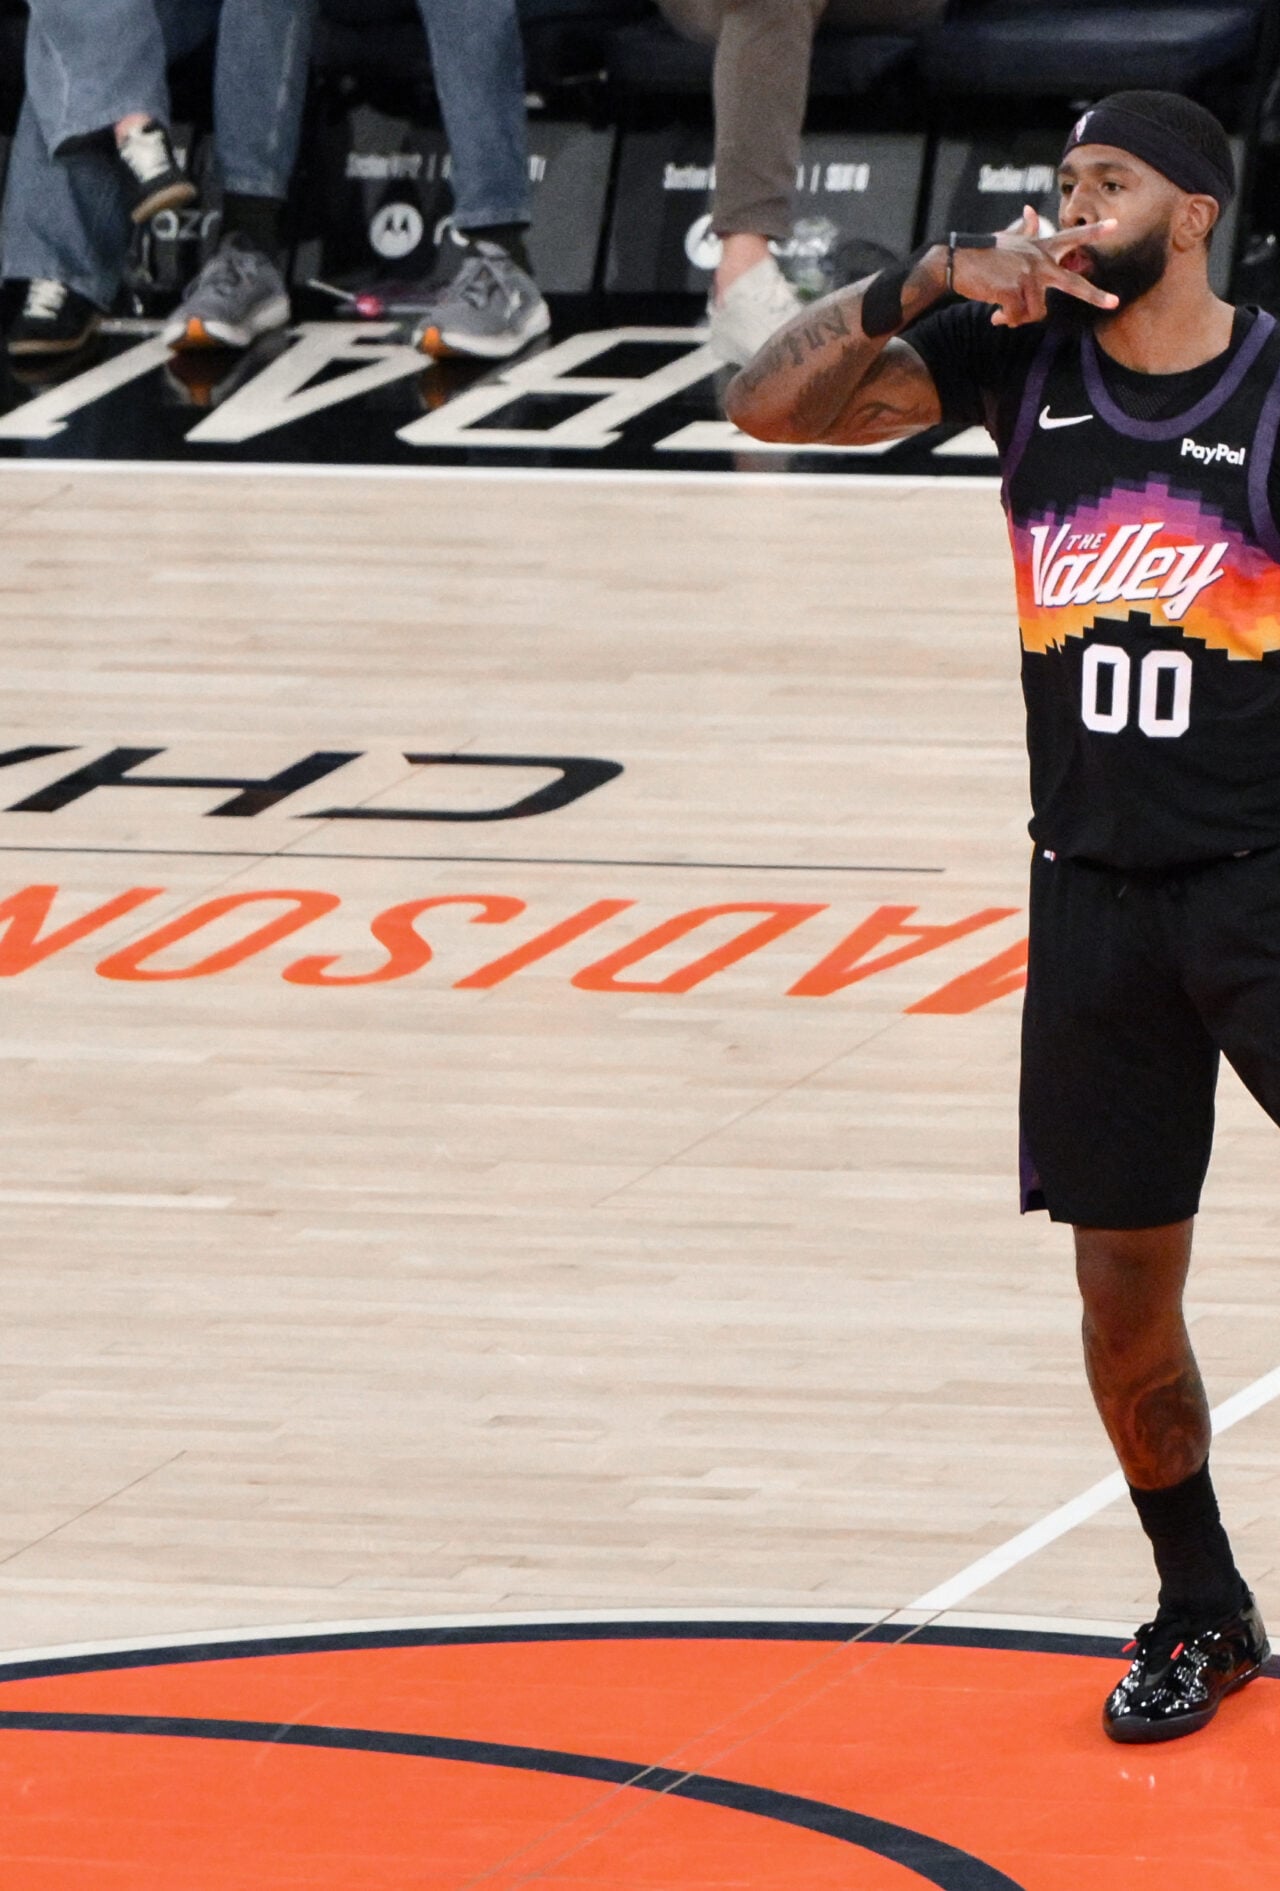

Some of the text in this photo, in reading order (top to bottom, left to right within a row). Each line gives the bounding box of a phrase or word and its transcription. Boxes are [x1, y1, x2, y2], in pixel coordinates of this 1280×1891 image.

[1181, 439, 1245, 465] PayPal
[1030, 522, 1228, 620] Valley
[1066, 533, 1106, 550] THE
[1082, 644, 1192, 737] 00
[0, 745, 624, 821] CH
